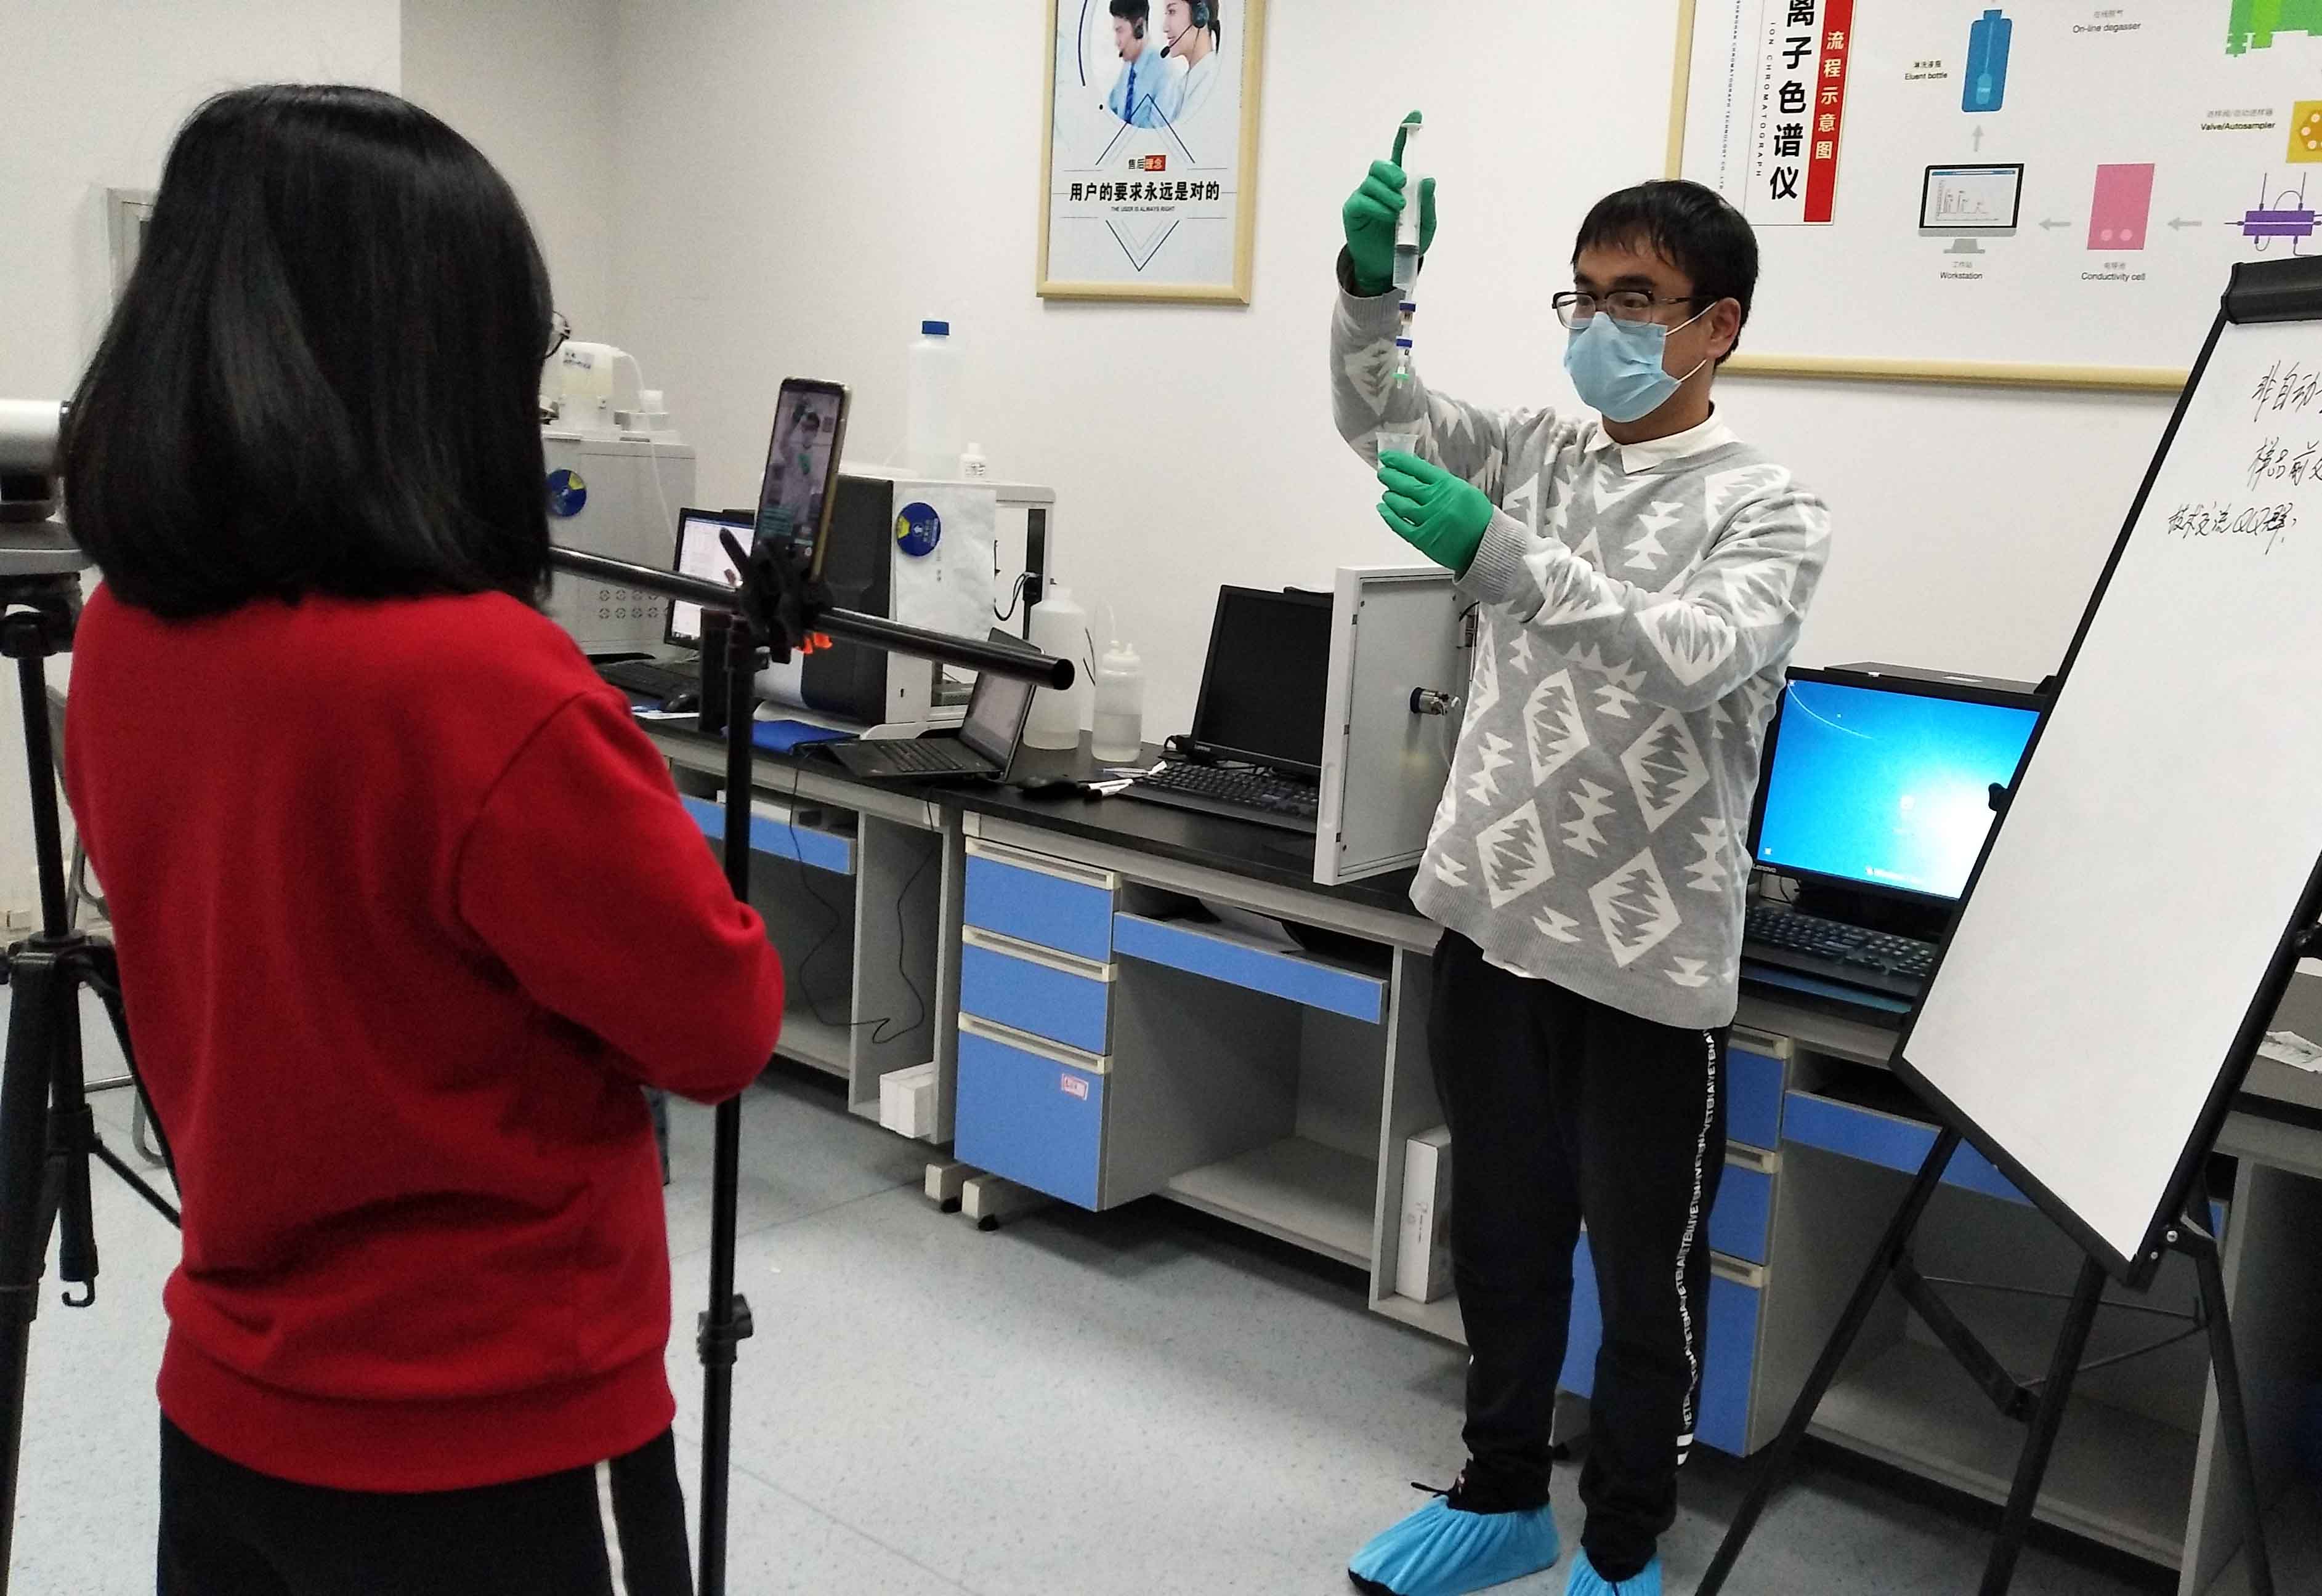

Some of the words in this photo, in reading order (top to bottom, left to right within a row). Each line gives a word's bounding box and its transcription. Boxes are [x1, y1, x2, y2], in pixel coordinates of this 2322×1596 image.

[1768, 22, 1776, 45] ION
[2073, 25, 2102, 33] On-line
[2103, 23, 2142, 33] degasser
[1770, 0, 1814, 200] 离子色谱仪
[1815, 31, 1845, 160] 流程示意图
[1755, 55, 1773, 177] CHROMATOGRAPH
[2201, 122, 2276, 131] Valve/Autosampler
[1069, 180, 1220, 201] 用户的要求永远是对的
[1940, 272, 1983, 280] Workstation
[2081, 272, 2130, 282] Conductivity
[2131, 272, 2146, 281] cell
[2251, 360, 2322, 423] 非自动
